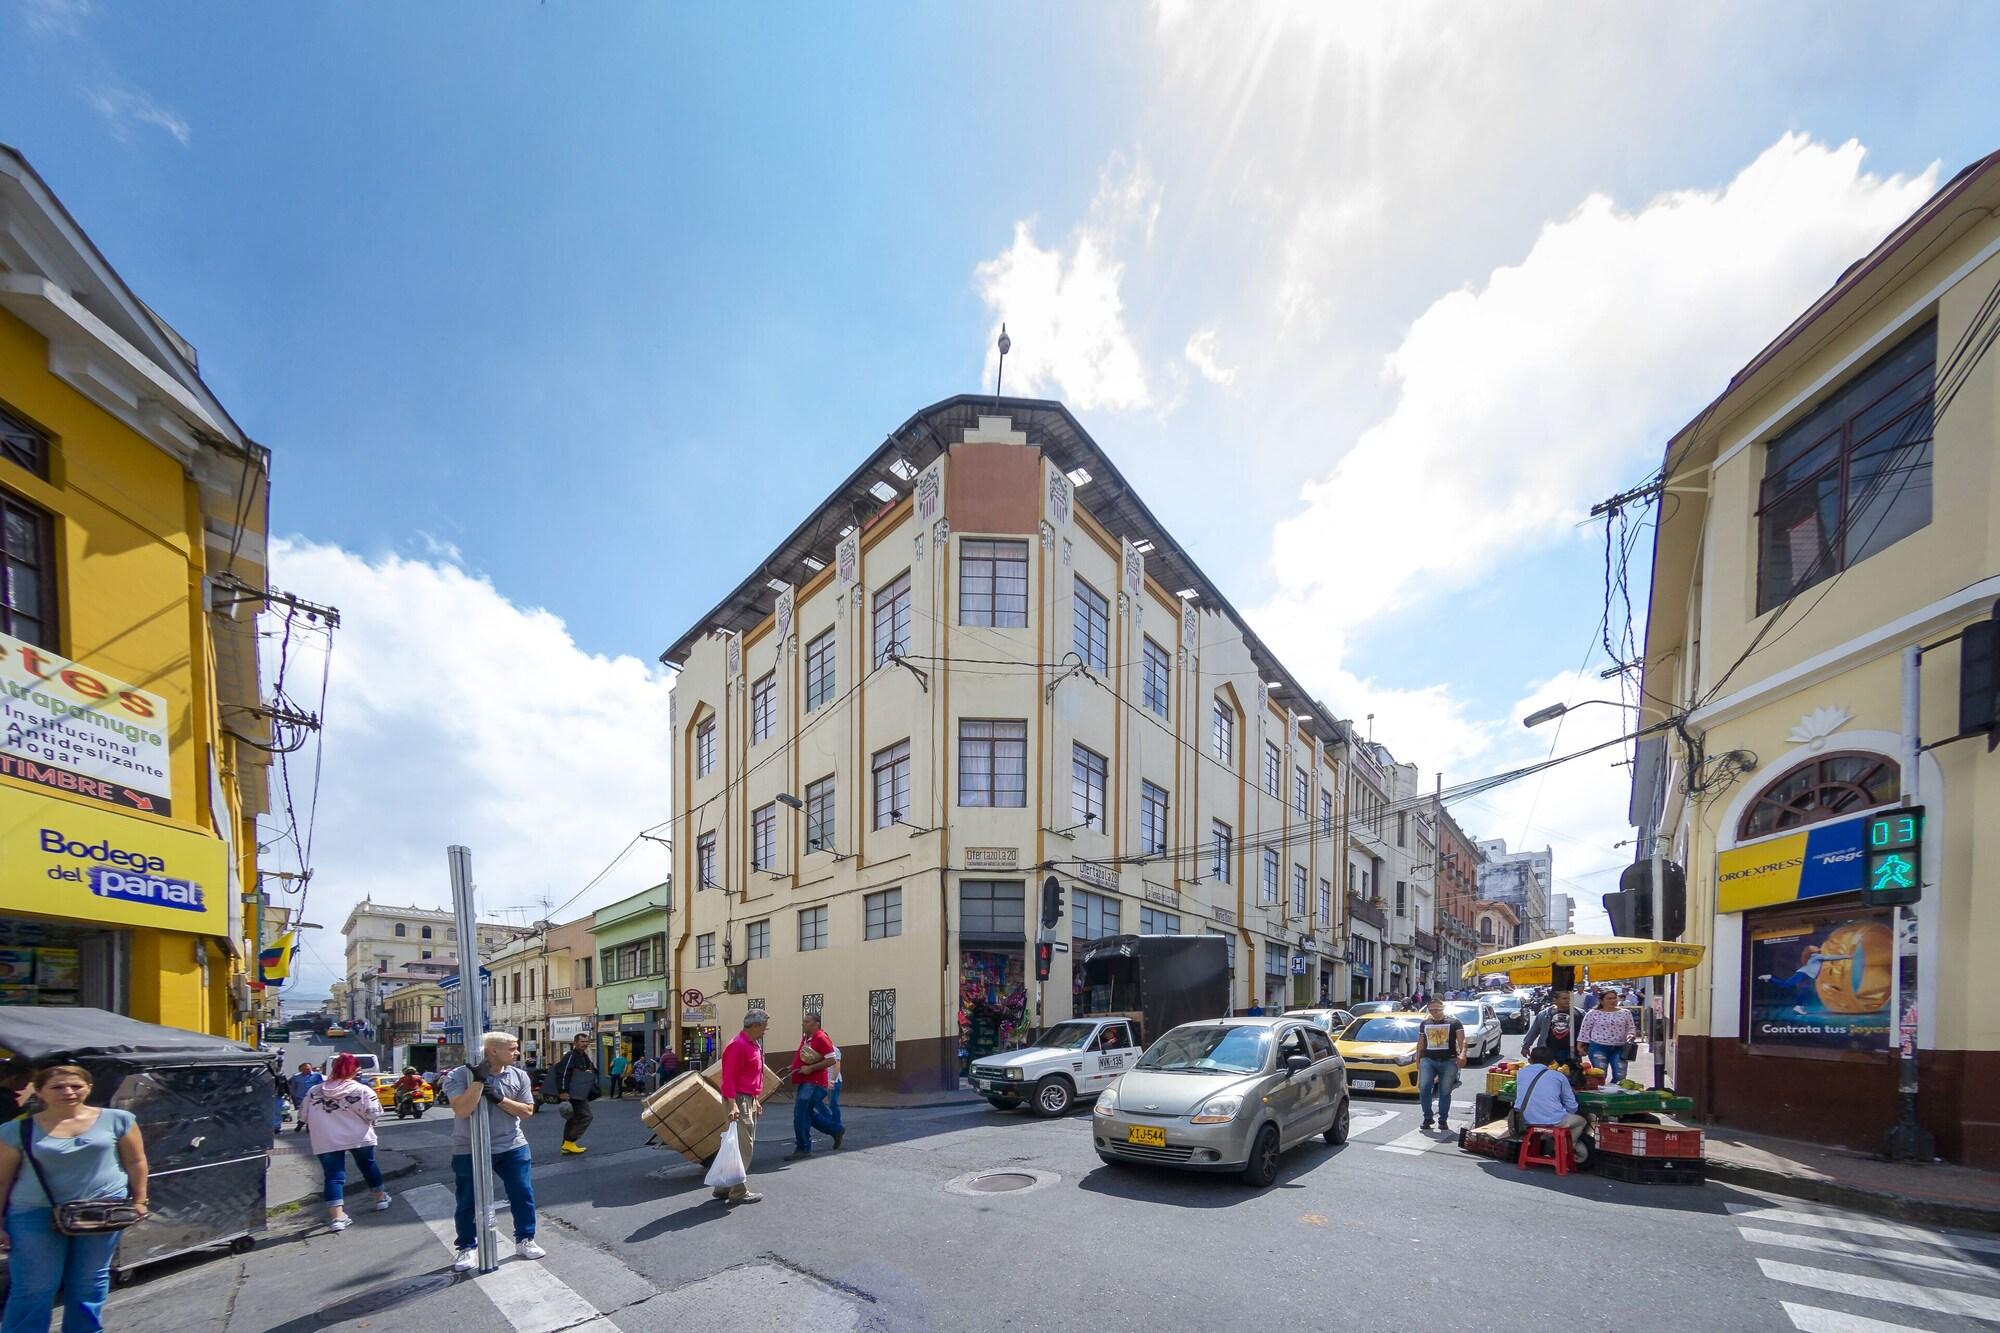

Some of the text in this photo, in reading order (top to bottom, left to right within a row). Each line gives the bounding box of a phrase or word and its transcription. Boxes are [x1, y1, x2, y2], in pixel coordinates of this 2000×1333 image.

[0, 644, 155, 718] tes
[5, 704, 136, 757] Institucional
[7, 734, 81, 765] Hogar
[7, 722, 164, 778] Antideslizante
[0, 754, 114, 801] TIMBRE
[1871, 818, 1915, 846] 03
[40, 828, 165, 874] Bodega
[47, 865, 198, 906] del pañal
[1718, 857, 1804, 883] OROEXPRESS
[1481, 952, 1543, 967] OROEXPRESS
[1563, 946, 1644, 957] OROEXPRESS
[1762, 1024, 1821, 1034] Contrata
[1824, 1025, 1847, 1034] tus
